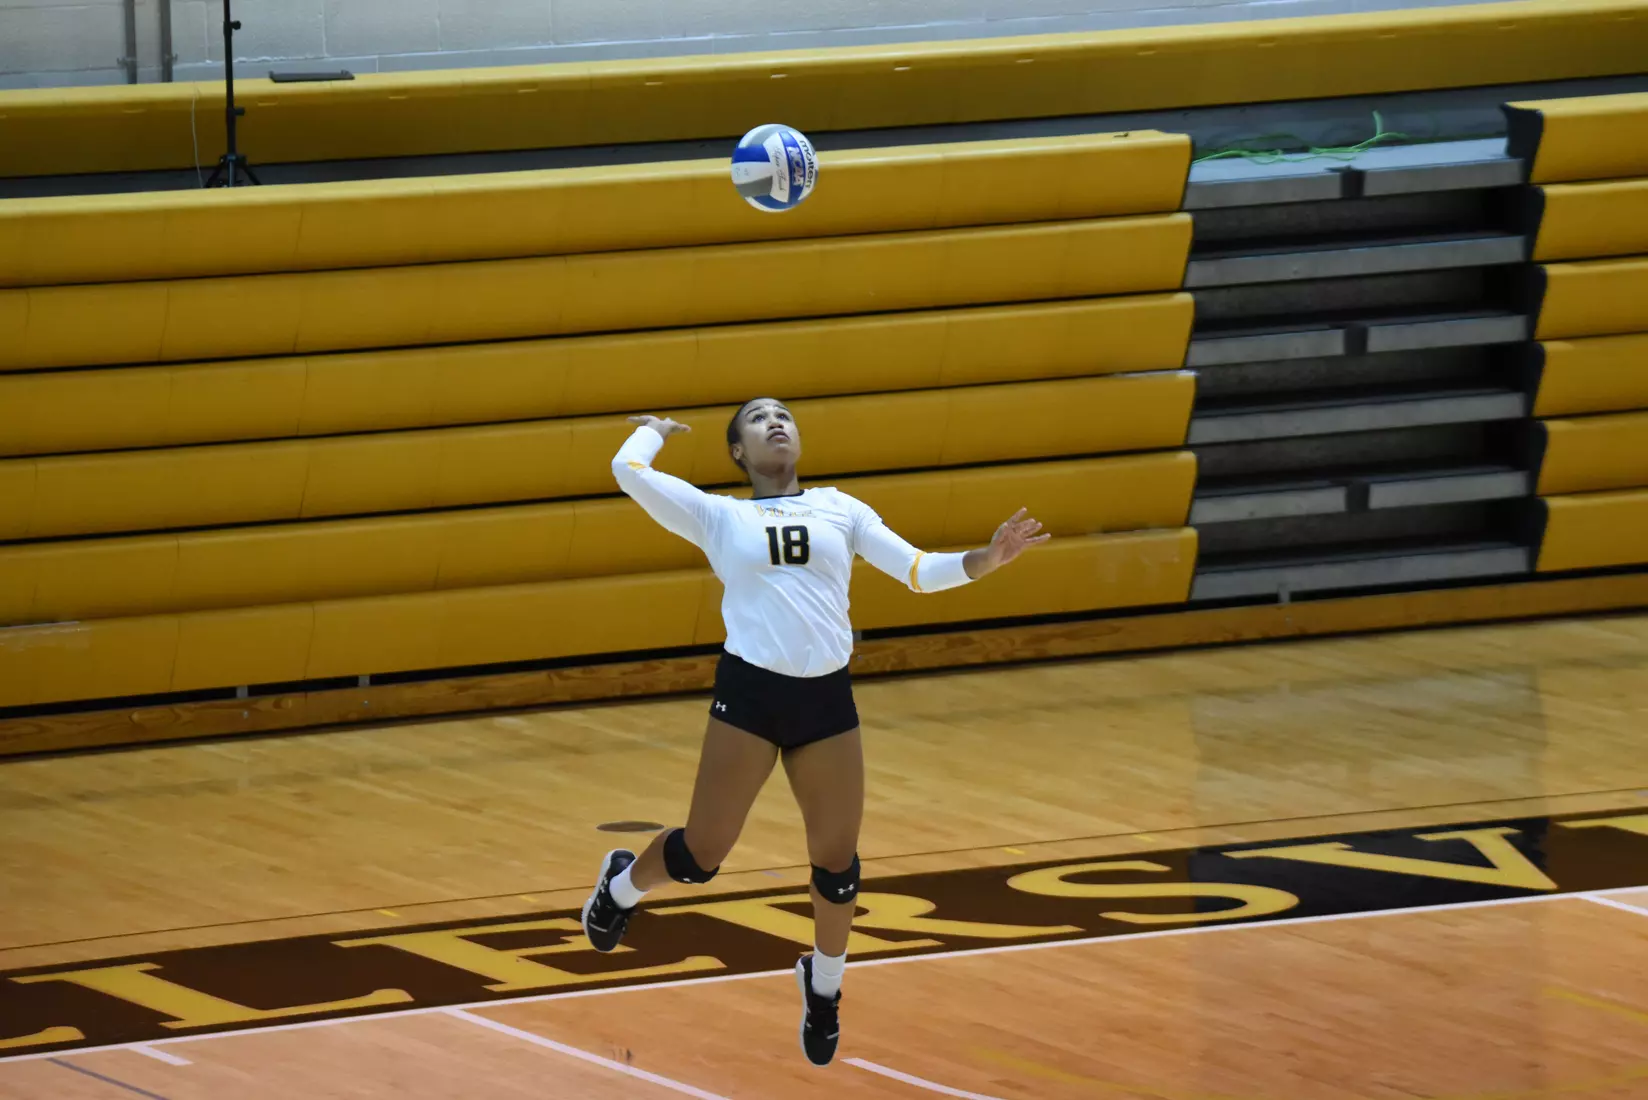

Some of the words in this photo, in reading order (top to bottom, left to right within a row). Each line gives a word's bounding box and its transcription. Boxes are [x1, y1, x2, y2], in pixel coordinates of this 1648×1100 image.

[786, 146, 804, 186] NCAA
[799, 140, 814, 188] molten
[765, 525, 810, 566] 18
[0, 814, 1648, 1049] LERSV
